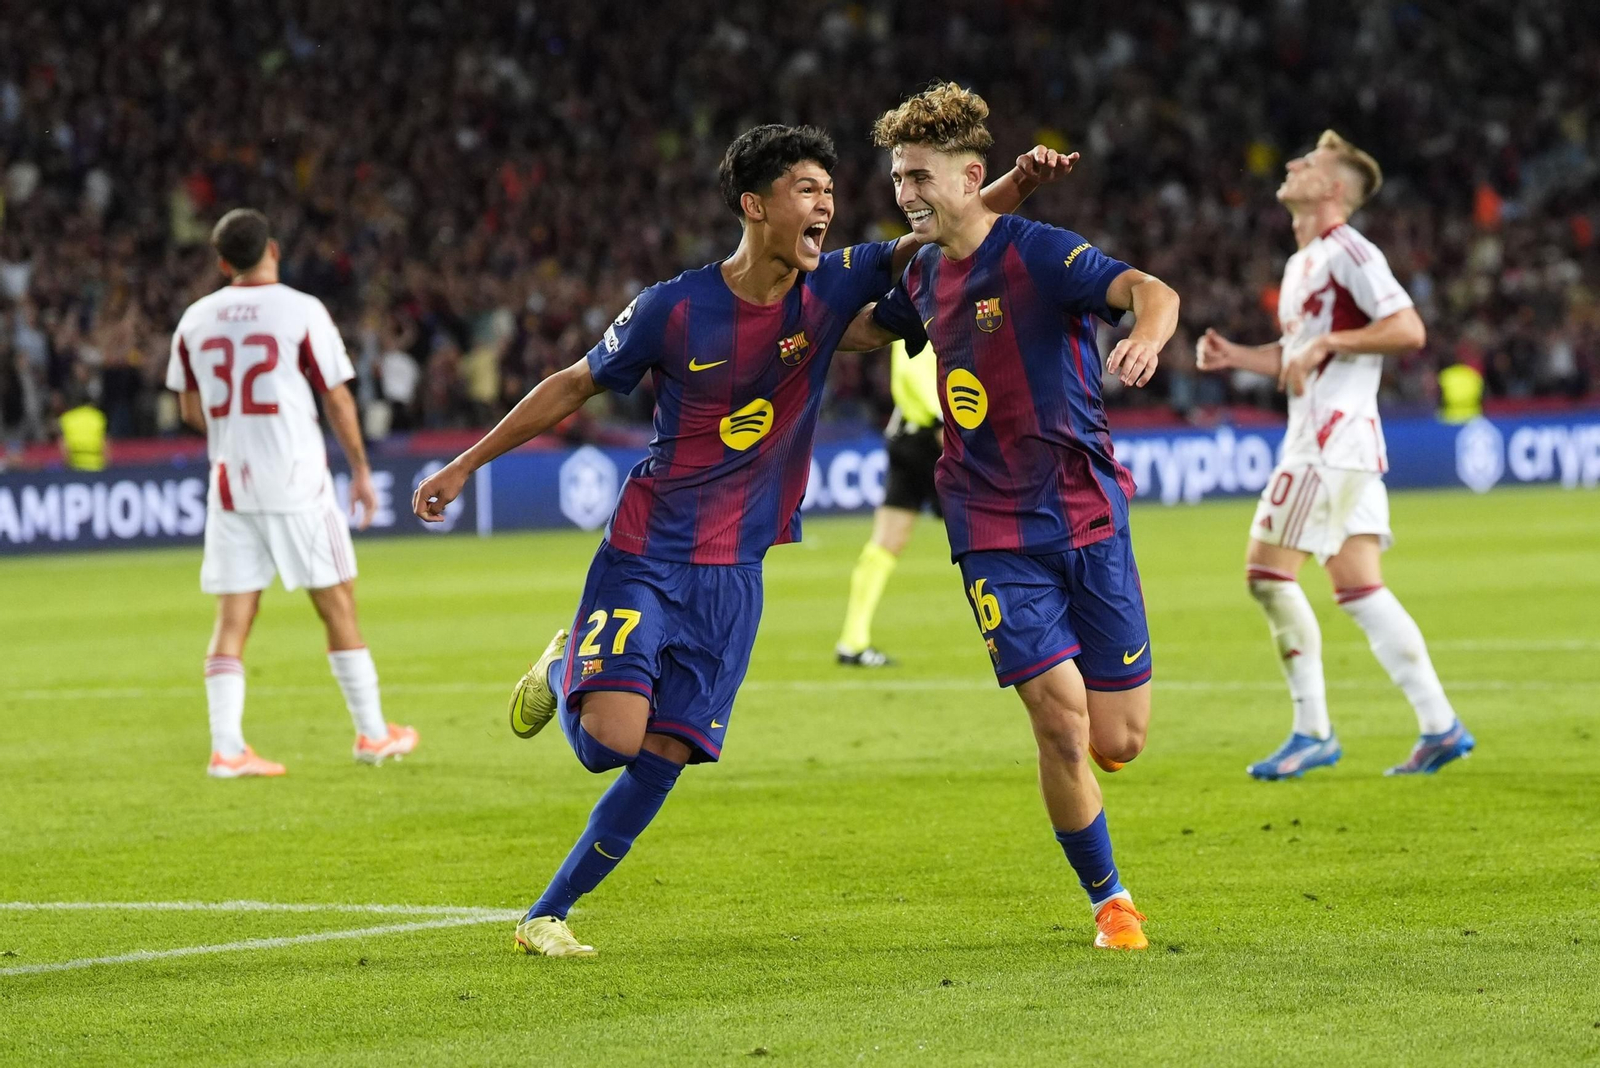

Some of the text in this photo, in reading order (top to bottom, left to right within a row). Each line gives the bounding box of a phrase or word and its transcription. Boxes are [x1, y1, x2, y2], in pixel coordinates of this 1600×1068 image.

[201, 334, 279, 419] 32
[578, 609, 642, 657] 27
[970, 578, 1002, 634] 16
